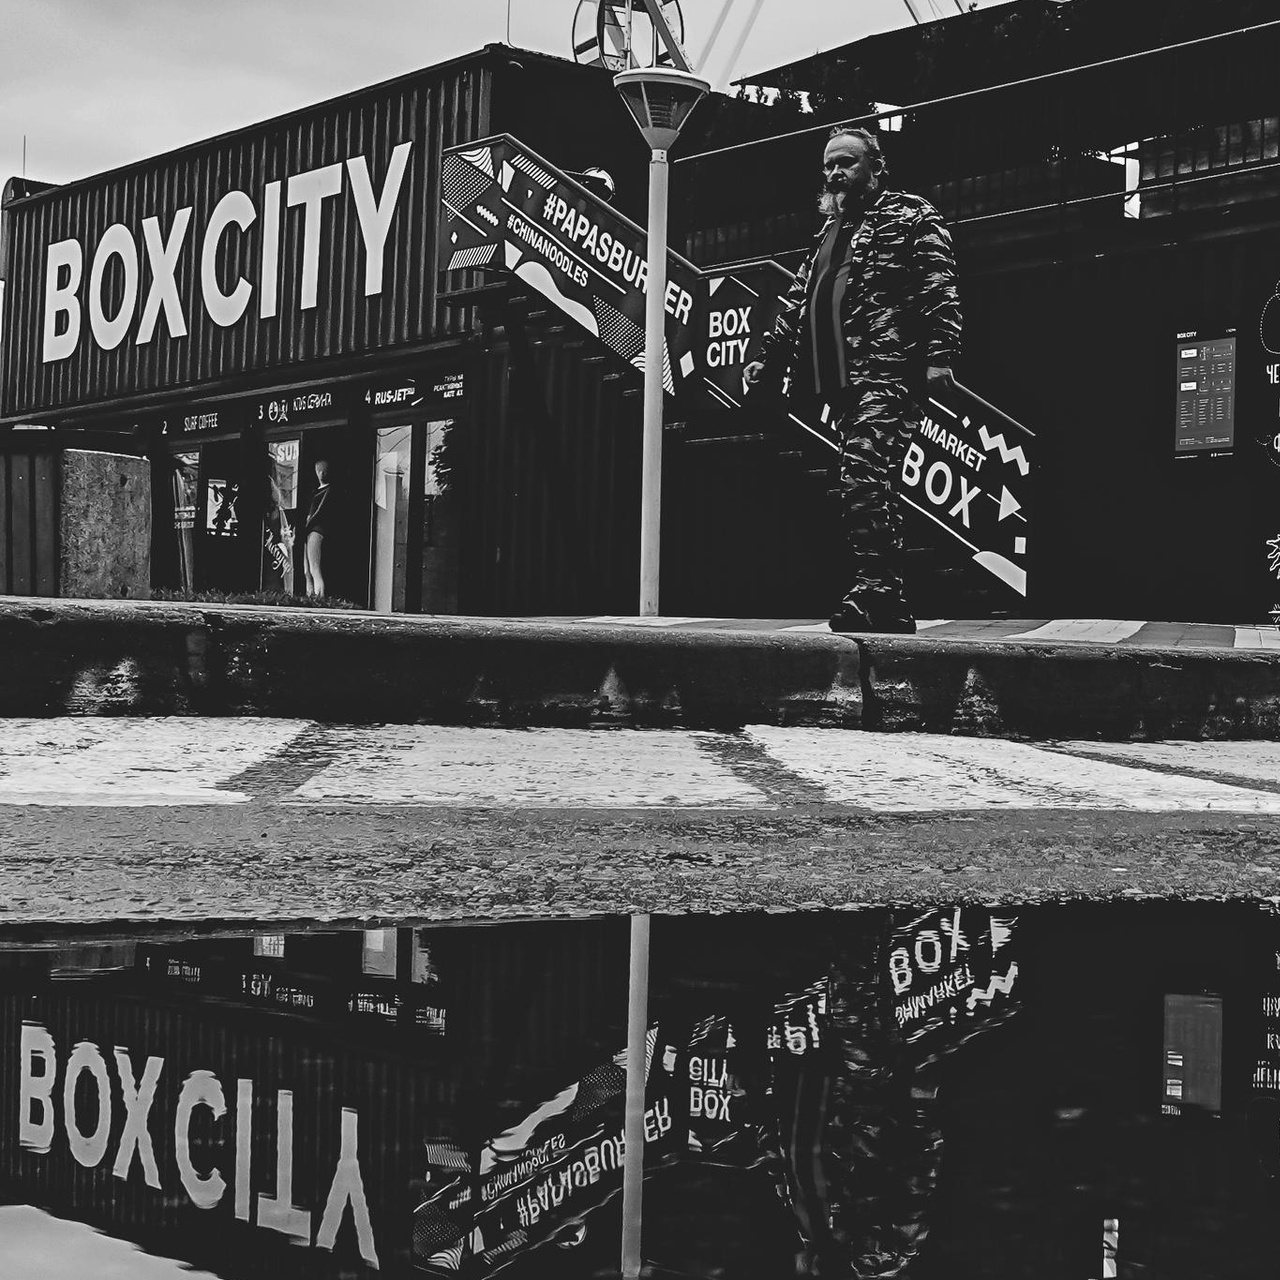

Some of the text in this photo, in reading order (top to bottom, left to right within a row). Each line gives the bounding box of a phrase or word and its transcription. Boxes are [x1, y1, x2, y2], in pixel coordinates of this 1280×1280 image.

[507, 213, 589, 288] #CHINANOODLES
[543, 193, 693, 326] #PAPASBURER
[709, 306, 752, 338] BOX
[706, 338, 750, 368] CITY
[258, 405, 263, 420] 3
[364, 389, 371, 404] 4
[162, 421, 168, 435] 2
[198, 413, 218, 430] COFFEE
[919, 416, 988, 472] HMARKET
[902, 441, 982, 529] BOX
